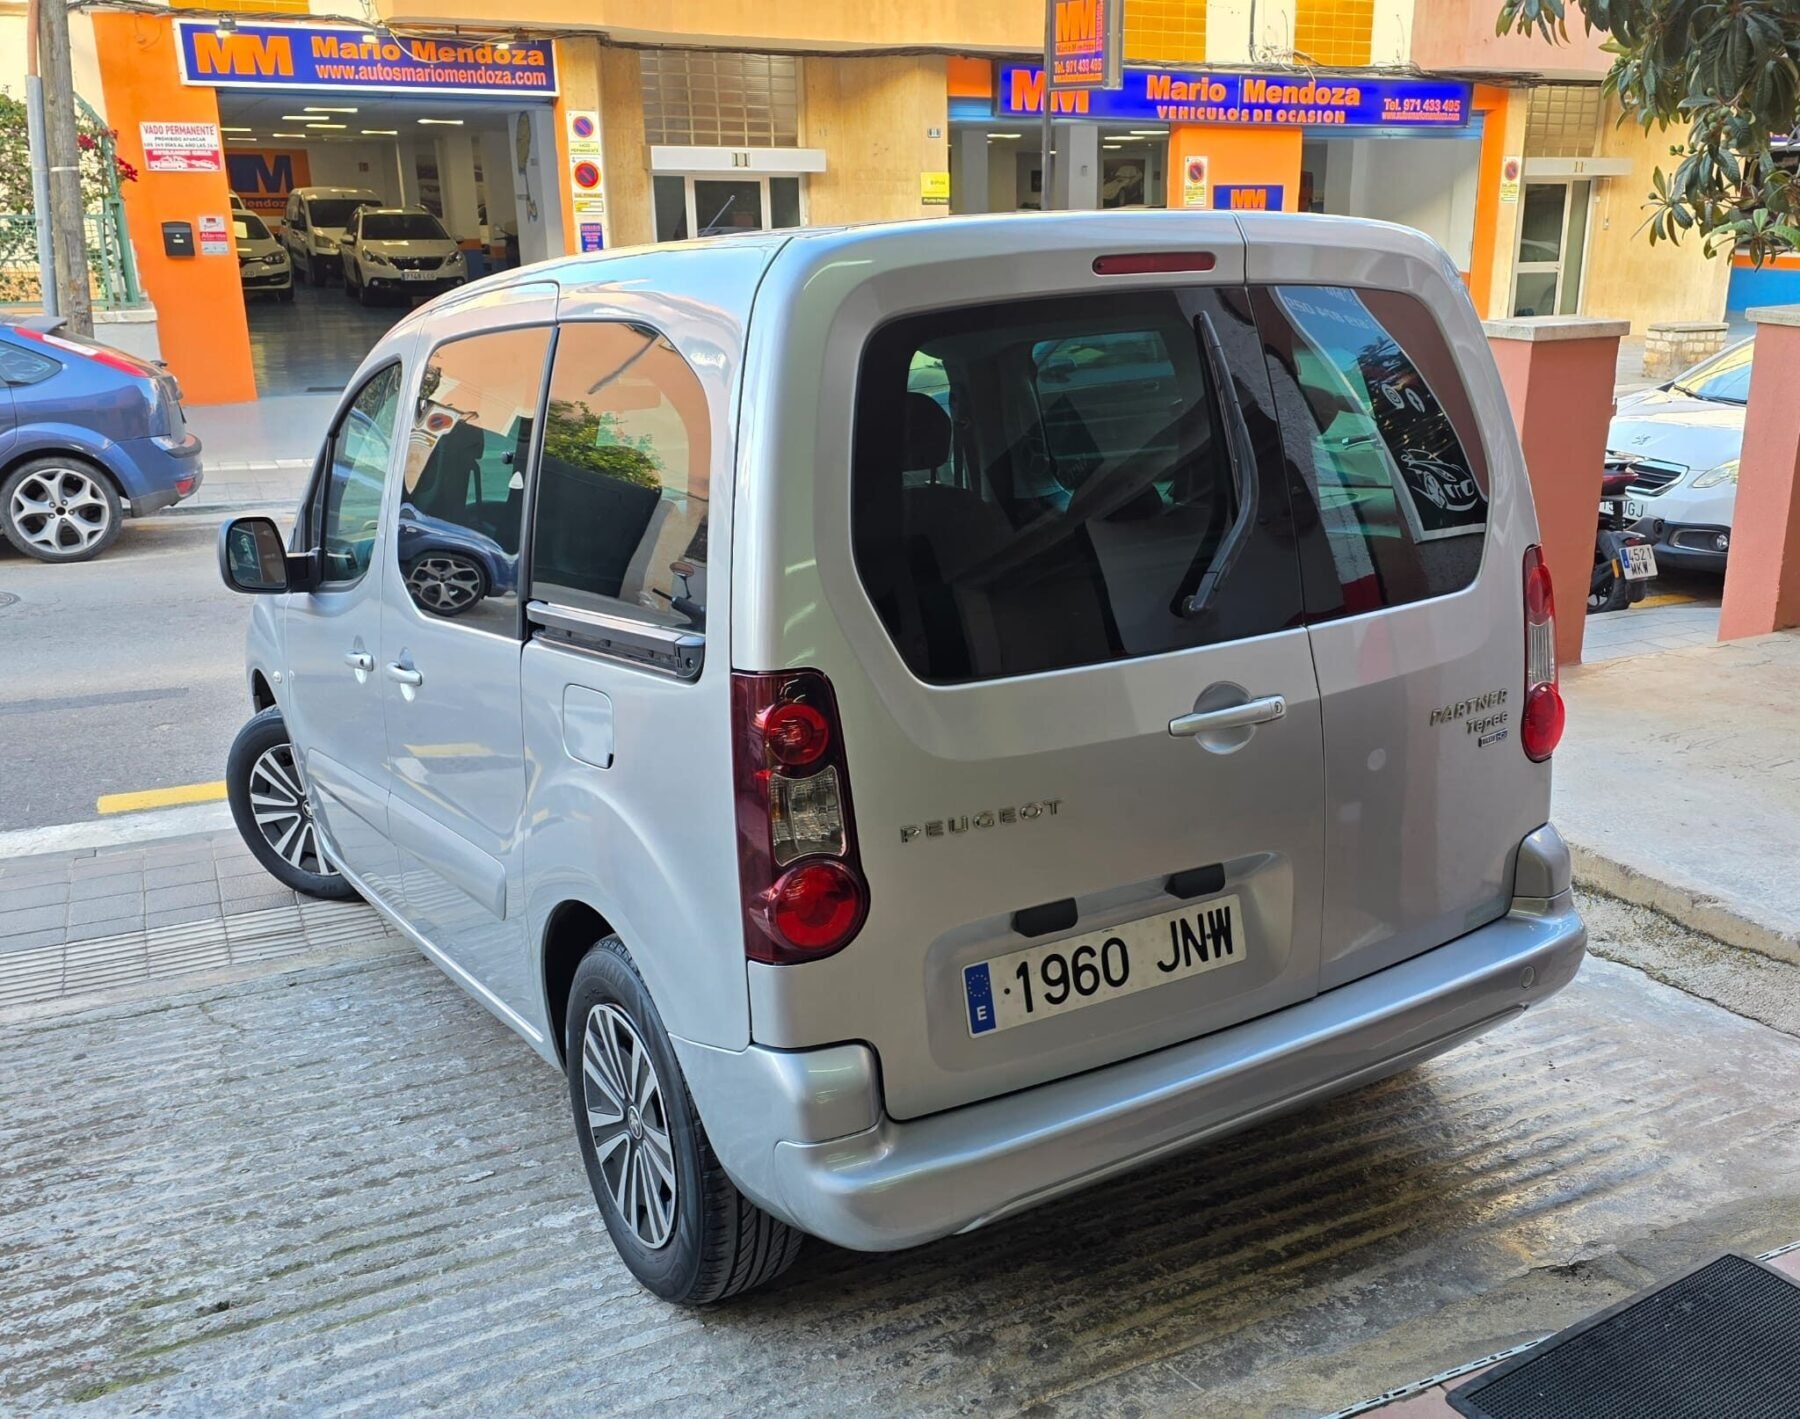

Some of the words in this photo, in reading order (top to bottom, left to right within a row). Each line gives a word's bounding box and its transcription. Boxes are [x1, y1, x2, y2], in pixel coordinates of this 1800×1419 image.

[1055, 0, 1096, 42] MM
[193, 32, 294, 76] MM
[311, 36, 401, 61] Mario
[411, 40, 546, 66] Mendoza
[315, 61, 547, 86] www.autosmariomendoza.com
[1066, 60, 1077, 73] 971
[1146, 75, 1226, 102] Mario
[1243, 79, 1360, 105] Mendoza
[1157, 105, 1249, 121] VEHICULOS
[1253, 109, 1272, 121] DE
[1276, 109, 1345, 123] OCASION
[1384, 98, 1401, 110] Tel.
[1403, 98, 1421, 110] 971
[1423, 99, 1441, 111] 433
[144, 125, 164, 135] VADO
[165, 125, 215, 136] PERMANENTE
[734, 152, 749, 167] 11
[1574, 161, 1584, 173] 11
[1231, 189, 1266, 209] MM
[1630, 547, 1652, 562] 4521
[1631, 561, 1649, 575] MKW
[1429, 688, 1507, 727] PARTNER
[1466, 711, 1508, 734] Tepee
[901, 800, 1062, 843] PEUGEOT
[976, 1005, 988, 1021] E
[1016, 937, 1130, 1013] 1960
[1157, 906, 1233, 973] JNW
